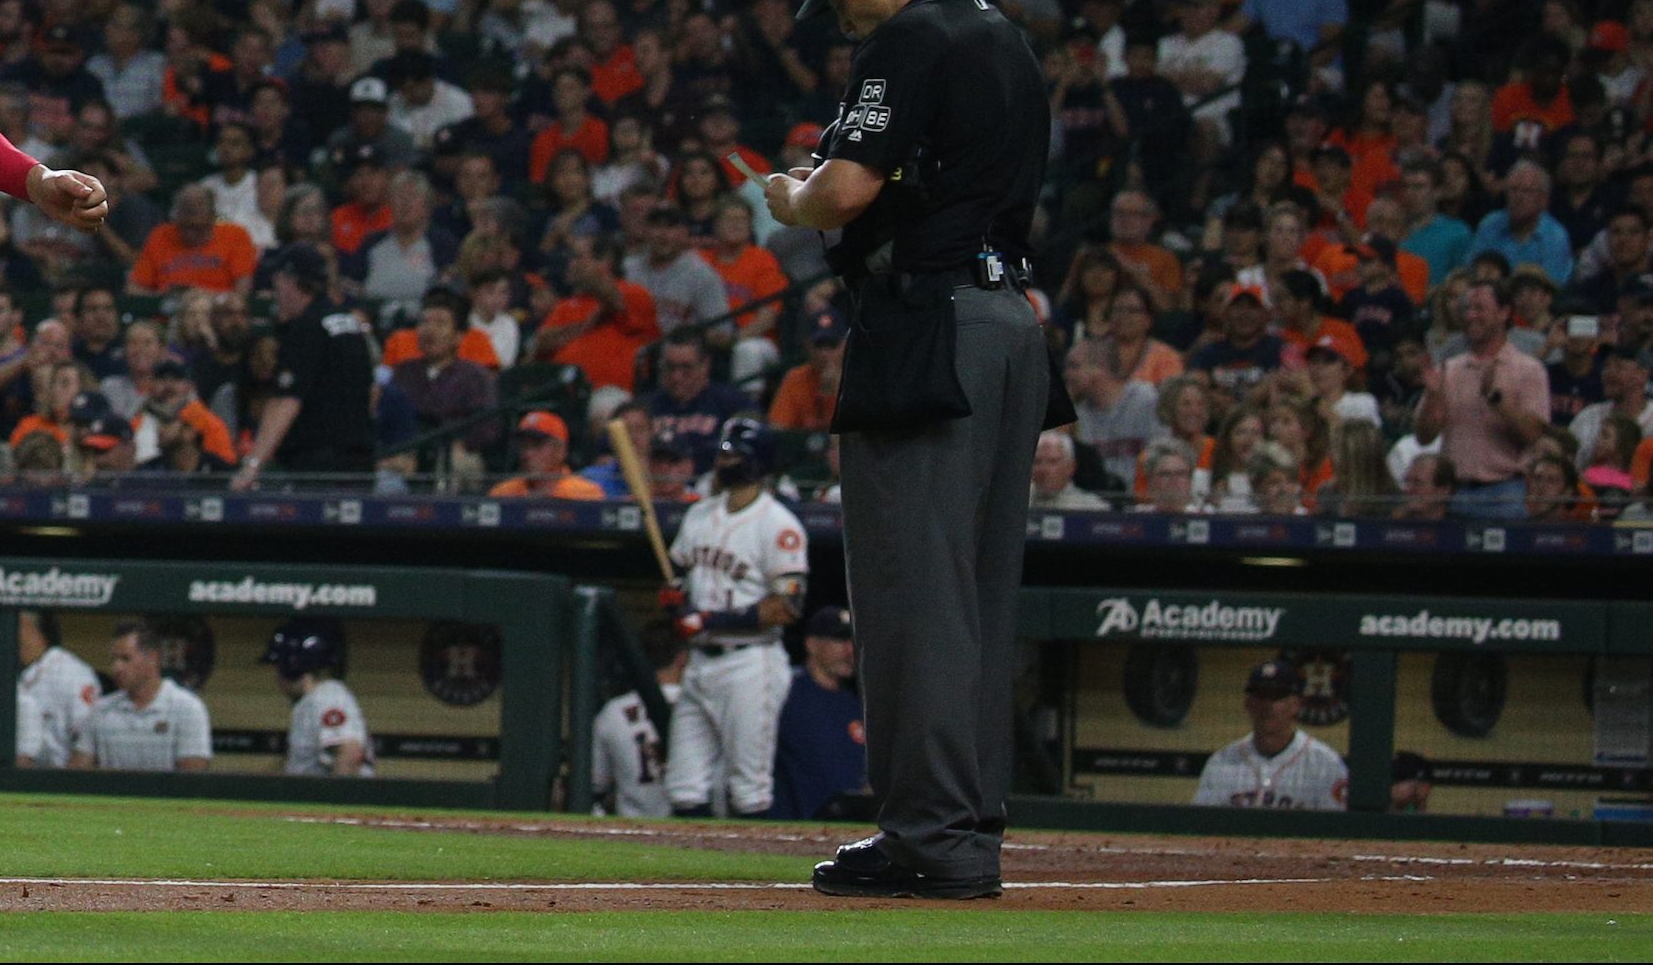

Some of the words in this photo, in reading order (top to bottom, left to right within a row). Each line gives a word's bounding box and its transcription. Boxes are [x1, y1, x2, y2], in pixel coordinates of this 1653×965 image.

[862, 84, 883, 99] DR
[189, 576, 377, 610] academy.com
[1141, 599, 1285, 639] Academy
[1359, 610, 1560, 644] academy.com
